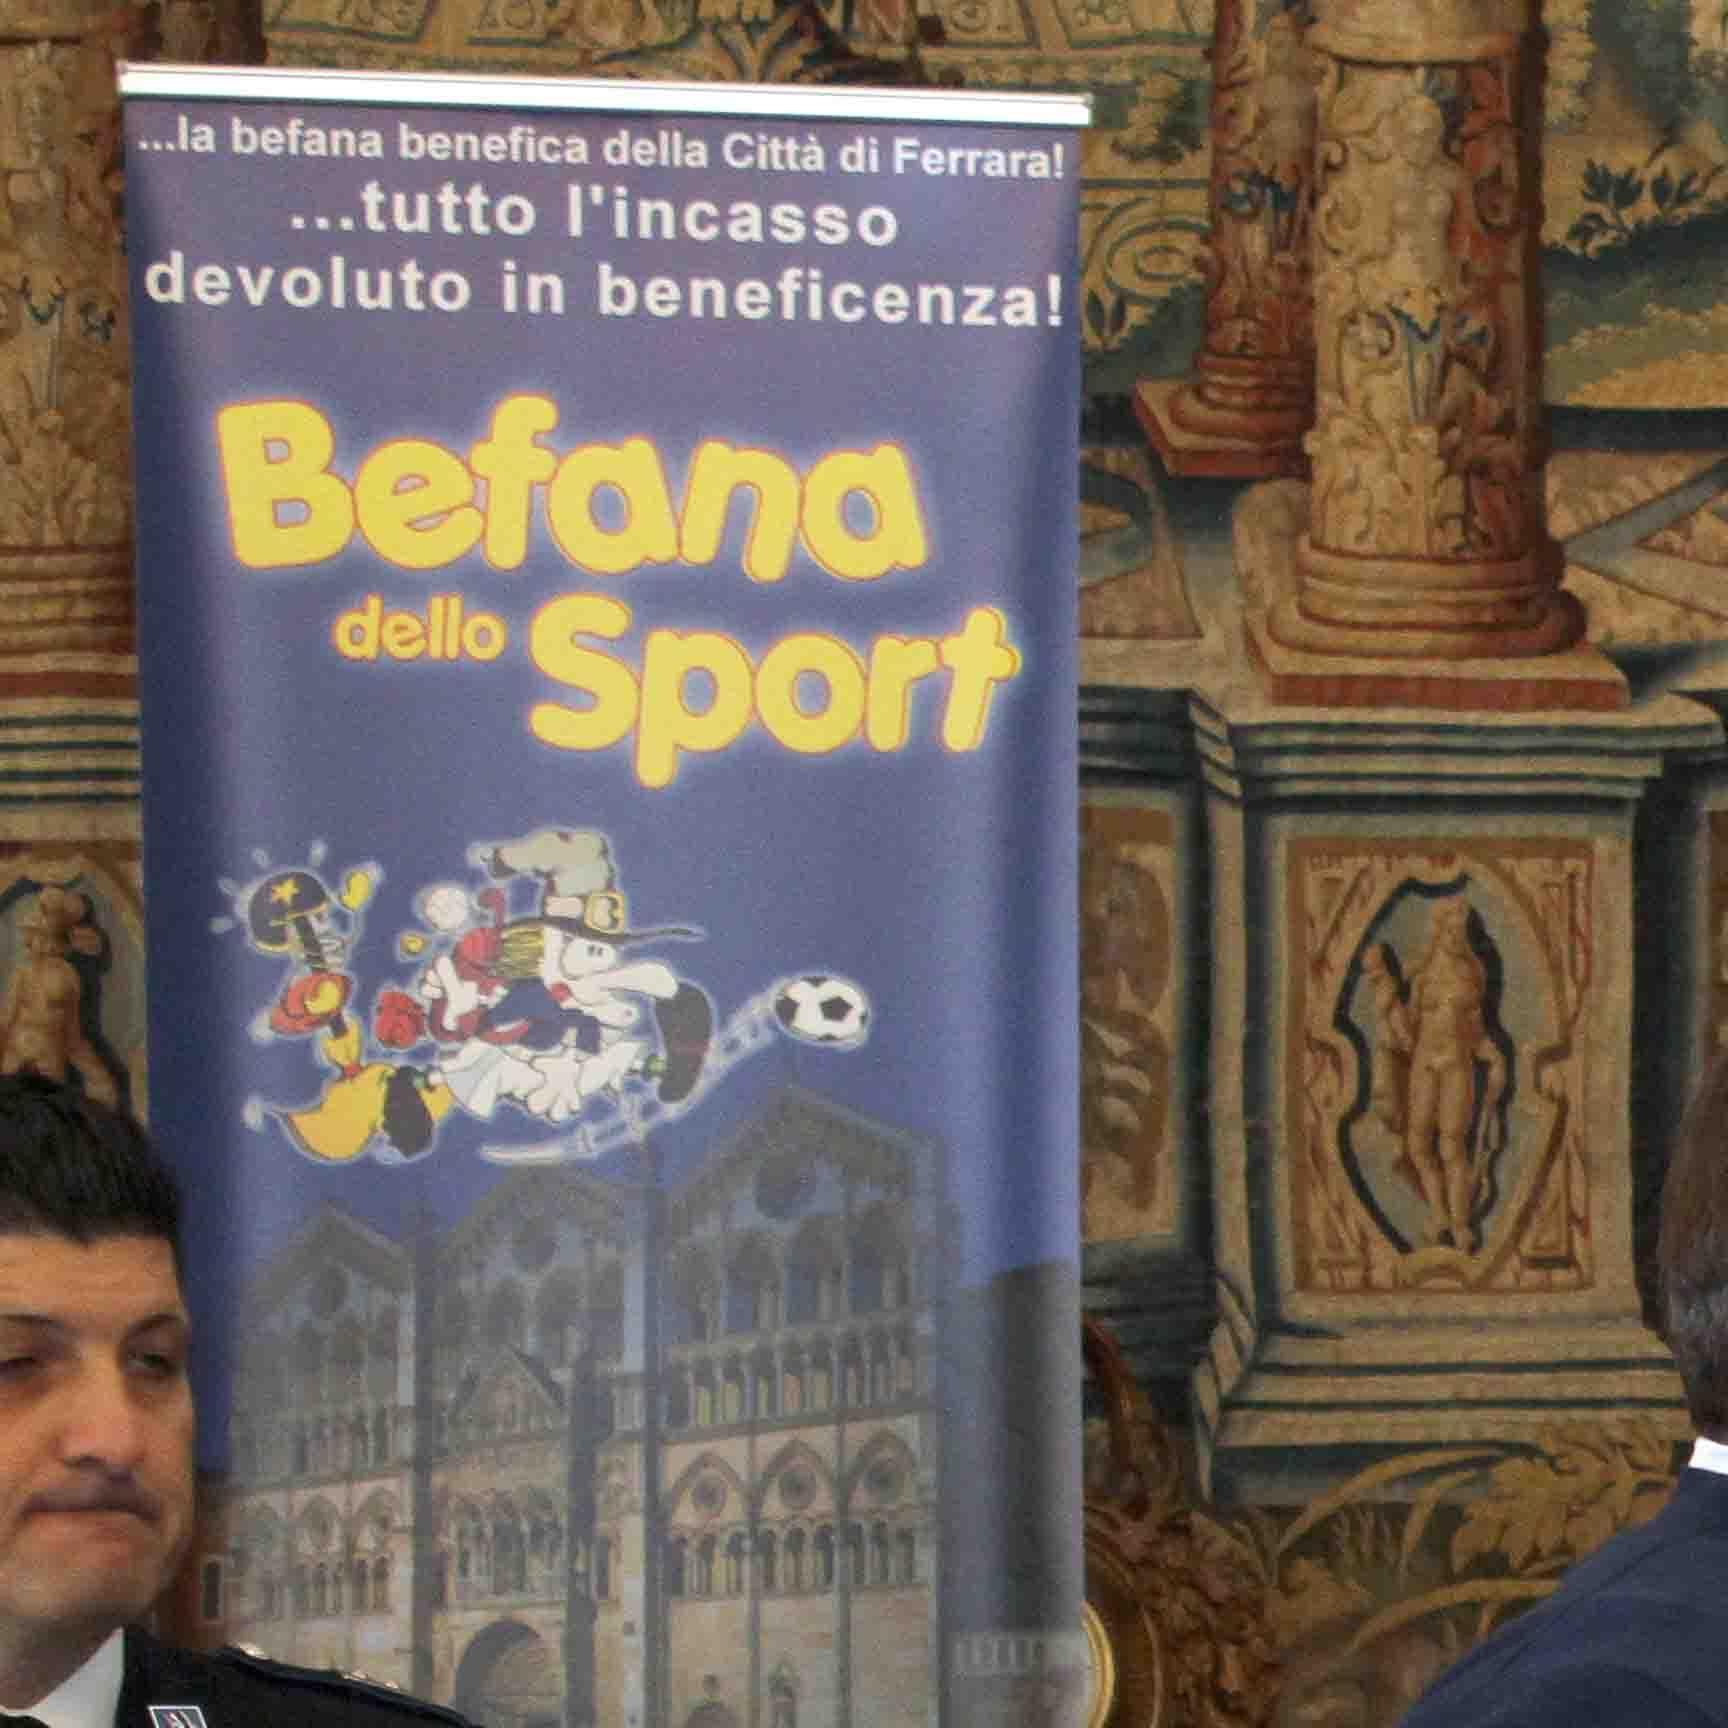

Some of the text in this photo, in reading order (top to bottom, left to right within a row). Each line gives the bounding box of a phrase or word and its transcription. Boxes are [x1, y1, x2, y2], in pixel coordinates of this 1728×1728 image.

[137, 115, 1066, 180] ...la befana benefica della Città di Ferrara!
[291, 182, 898, 247] ...tutto l'incasso
[145, 252, 1064, 328] devoluto in beneficenza!
[215, 391, 929, 582] Befana
[334, 592, 1022, 789] dello Sport
